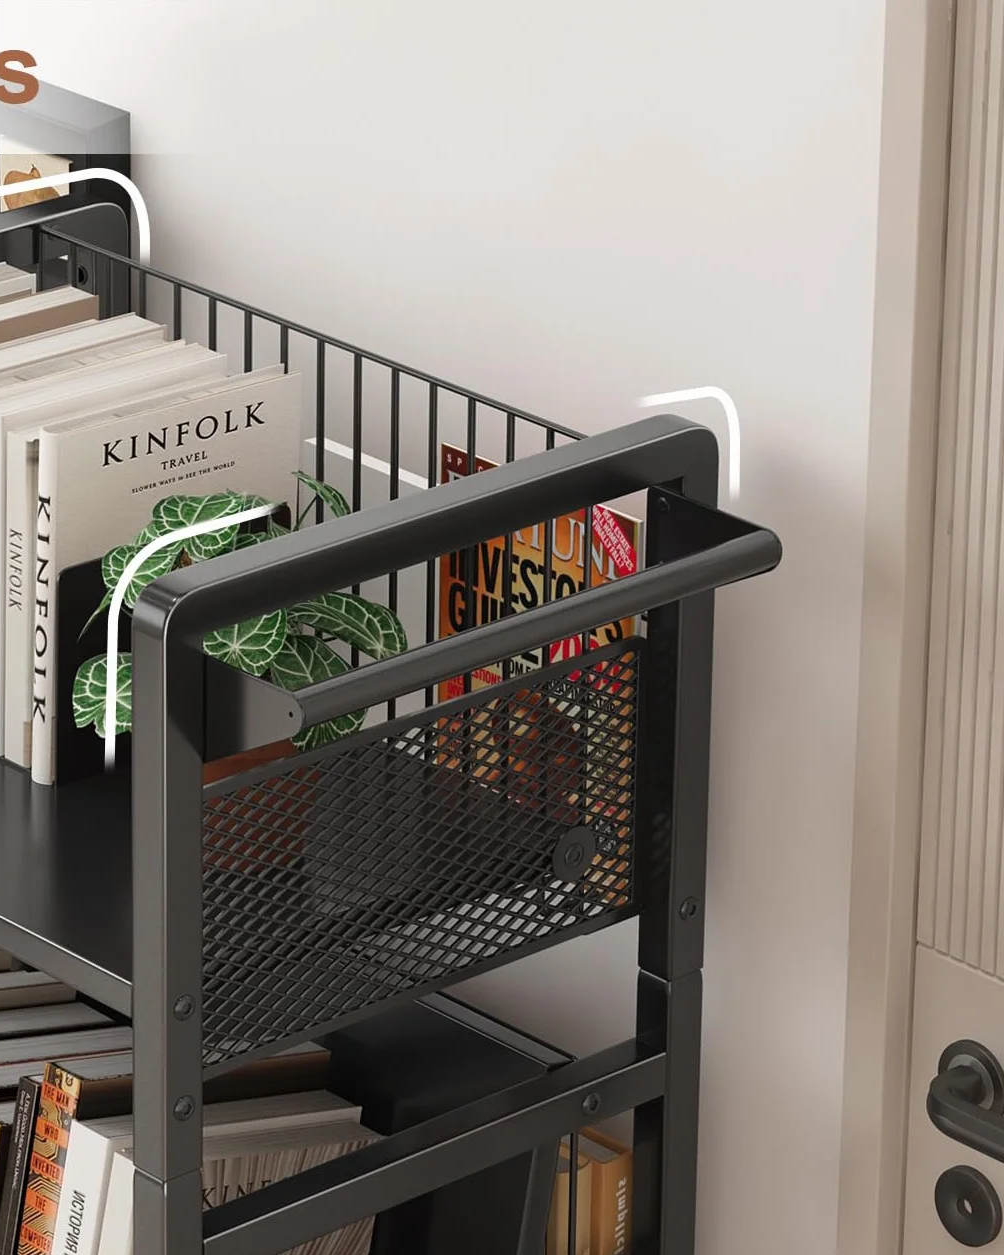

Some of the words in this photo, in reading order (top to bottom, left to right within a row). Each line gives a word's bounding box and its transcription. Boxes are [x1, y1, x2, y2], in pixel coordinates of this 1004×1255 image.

[102, 401, 265, 467] KINFOLK
[161, 450, 208, 471] TRAVEL
[131, 481, 157, 494] SLOWER
[159, 476, 176, 488] WAYS
[185, 470, 197, 480] SEE
[198, 466, 212, 476] THE
[213, 460, 236, 474] WORLD
[602, 508, 616, 530] REAL
[8, 528, 23, 611] KINFOLK
[32, 495, 51, 724] KINFOLK
[43, 1085, 56, 1102] THE
[44, 1124, 59, 1141] WHO
[32, 1155, 61, 1180] INVENTED
[35, 1195, 46, 1212] THE
[65, 1189, 86, 1254] ИСТОРИЯ
